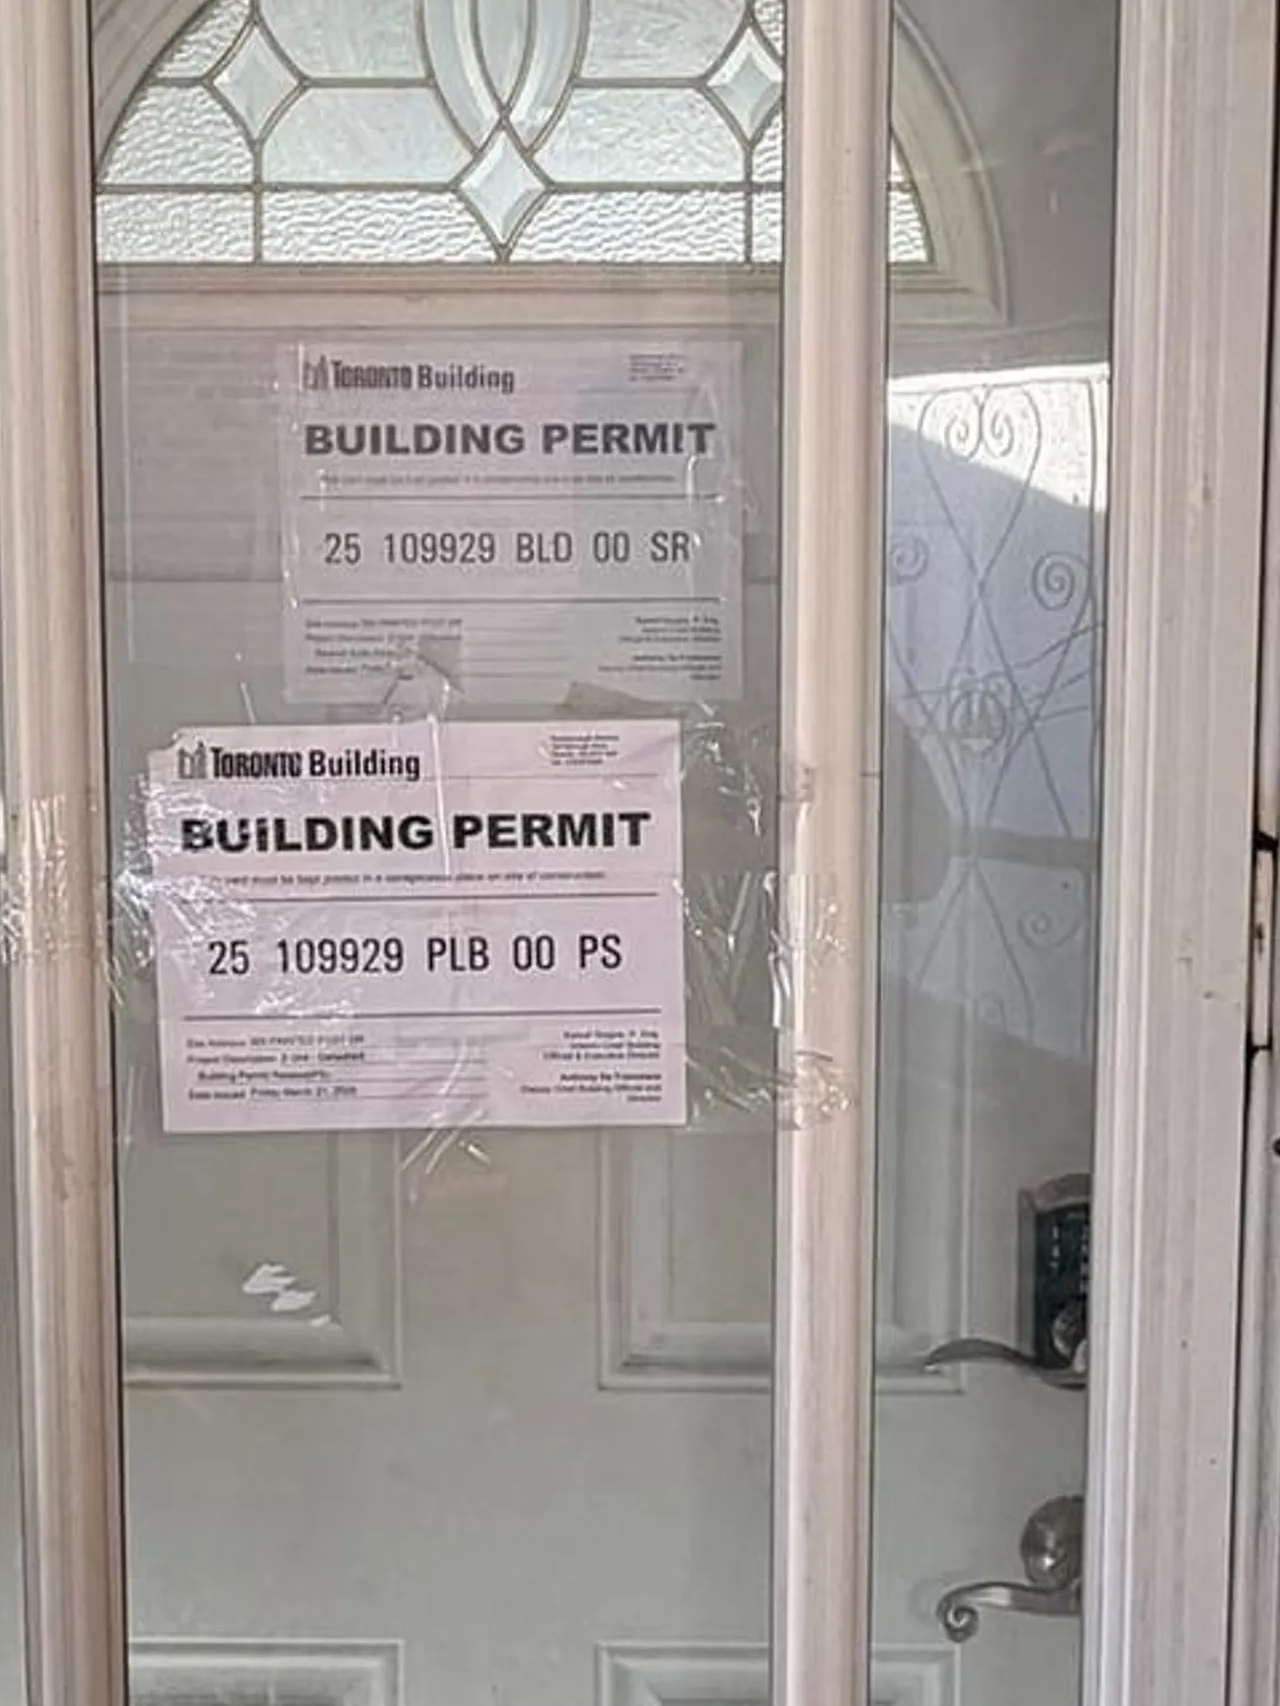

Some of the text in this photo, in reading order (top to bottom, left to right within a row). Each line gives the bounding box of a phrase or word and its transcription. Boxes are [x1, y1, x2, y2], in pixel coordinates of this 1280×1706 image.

[418, 363, 515, 394] Building
[304, 422, 716, 456] BUILDING PERMIT
[323, 530, 691, 566] 25 109929 BLD 00 SR
[210, 747, 421, 782] TORONTO Building
[181, 812, 651, 853] BUILDING PERMIT
[207, 933, 623, 976] 25 109929 PLB 00 PS
